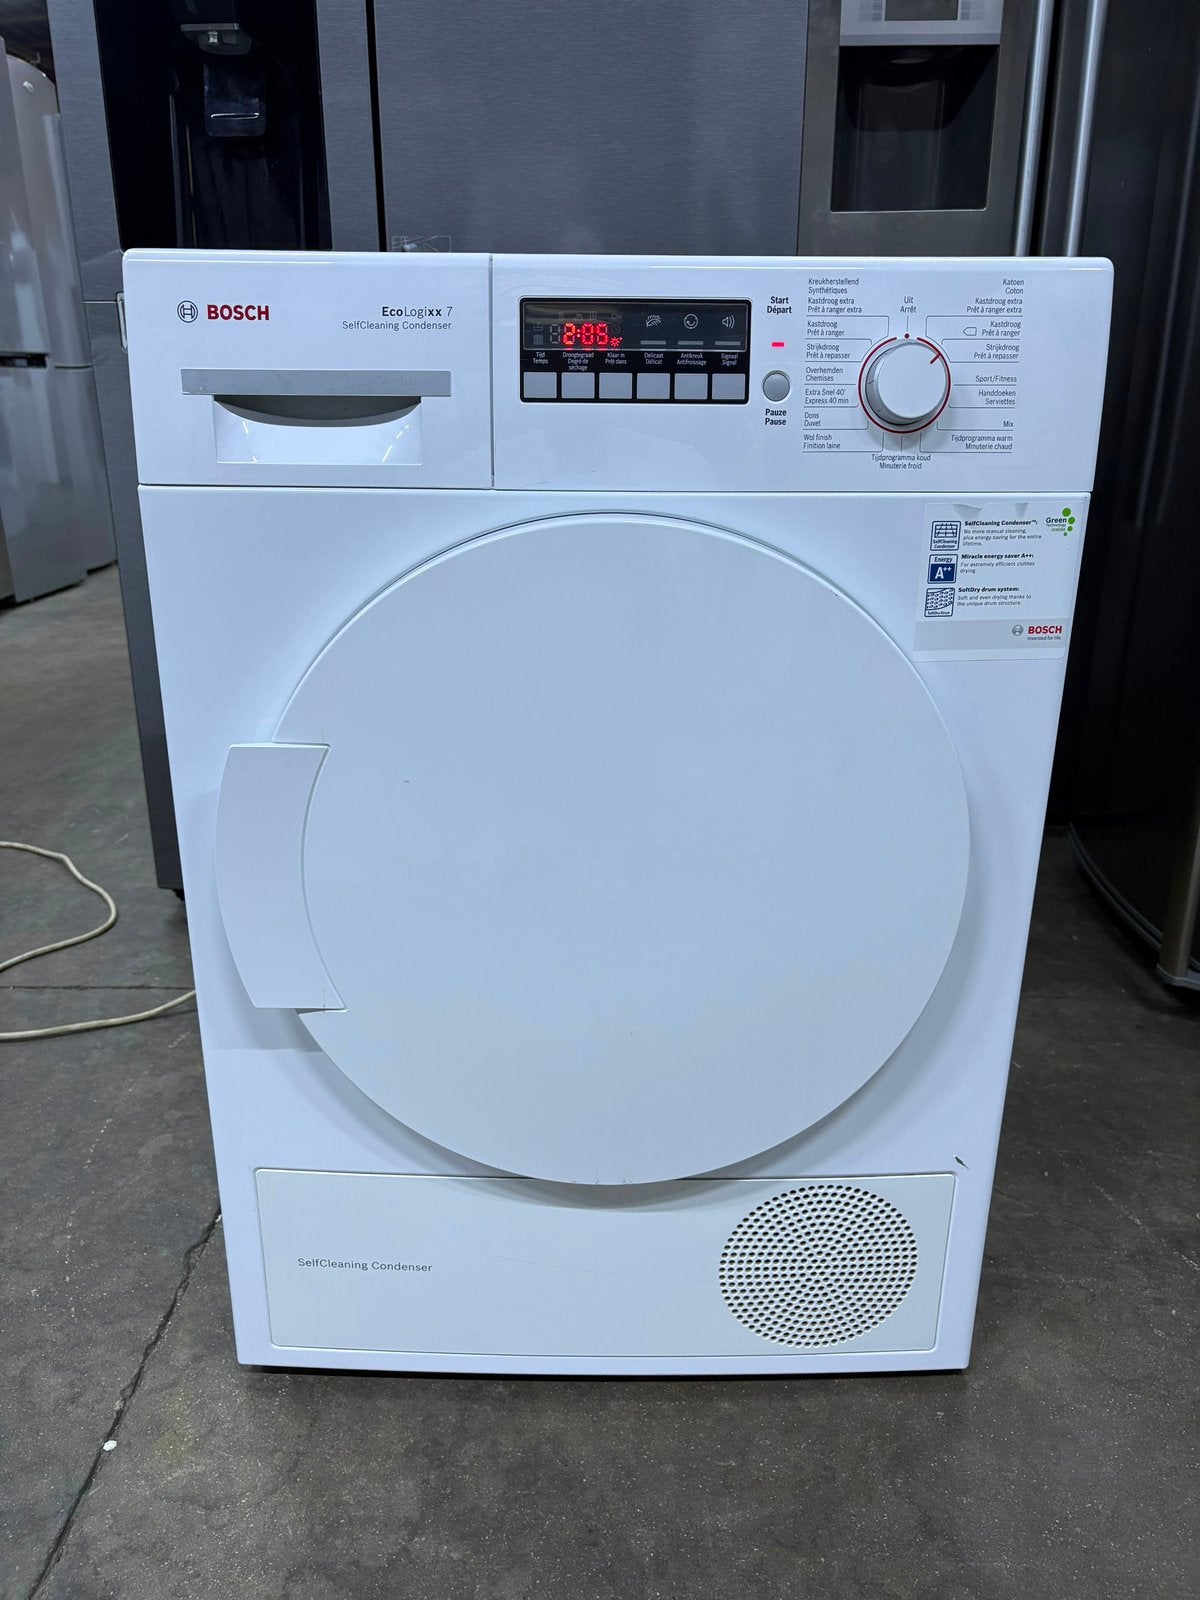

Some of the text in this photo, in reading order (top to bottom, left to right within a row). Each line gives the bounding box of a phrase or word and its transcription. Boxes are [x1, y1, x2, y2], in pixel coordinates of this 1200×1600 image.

[771, 296, 789, 304] Start
[808, 297, 838, 305] Kastdroog
[207, 305, 269, 321] BOSCH
[382, 306, 453, 319] EcoLogixx 7
[767, 306, 792, 314] Départ
[342, 321, 452, 331] SelfCleaning Condenser
[807, 321, 837, 329] Kastdroog
[991, 321, 1021, 329] Kastdroog
[563, 323, 608, 345] 2:05
[976, 375, 1017, 383] Sport/Fitness
[765, 418, 786, 426] Pause
[872, 454, 915, 462] Tijdprogramma
[1028, 626, 1062, 634] BOSCH
[298, 1258, 433, 1272] SelfCleaning Condenser
